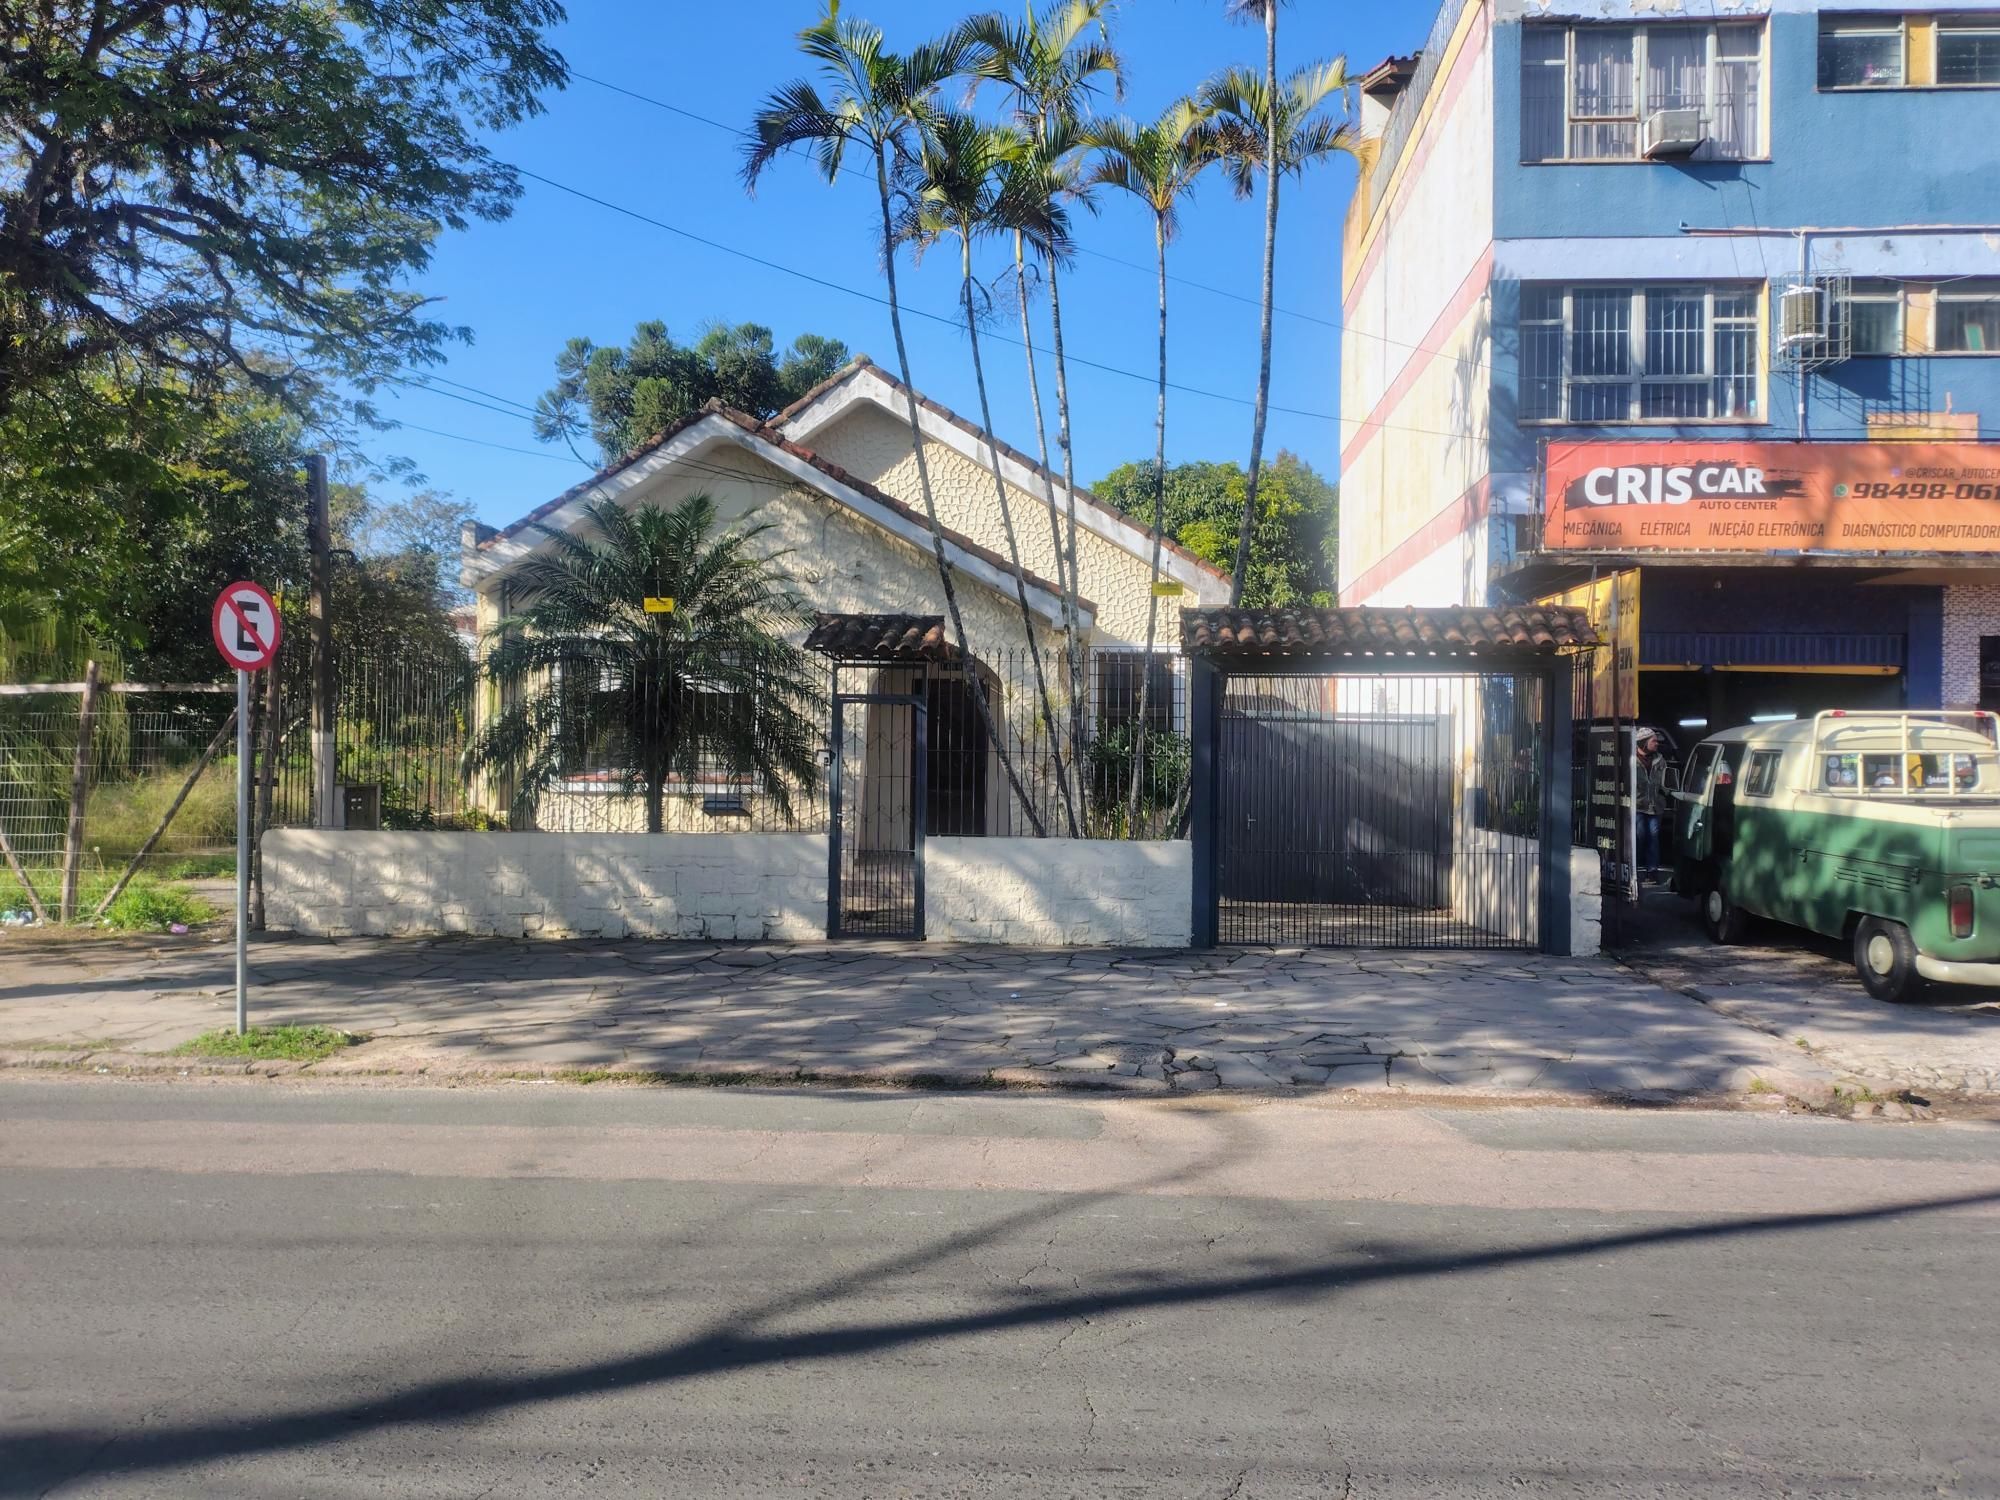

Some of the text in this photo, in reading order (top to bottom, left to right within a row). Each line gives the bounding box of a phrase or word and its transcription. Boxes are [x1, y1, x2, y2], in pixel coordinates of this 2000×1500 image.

[1584, 467, 1767, 505] CRIS CAR
[1699, 501, 1777, 511] AUTO CENTER
[1566, 520, 1623, 537] MECÂNICA
[1640, 520, 1691, 537] ELÉTRICA
[1708, 520, 1825, 539] INJEÇÃO ELETRÔNICA
[1842, 521, 1916, 538] DIAGNÓSTICO
[237, 601, 260, 652] E
